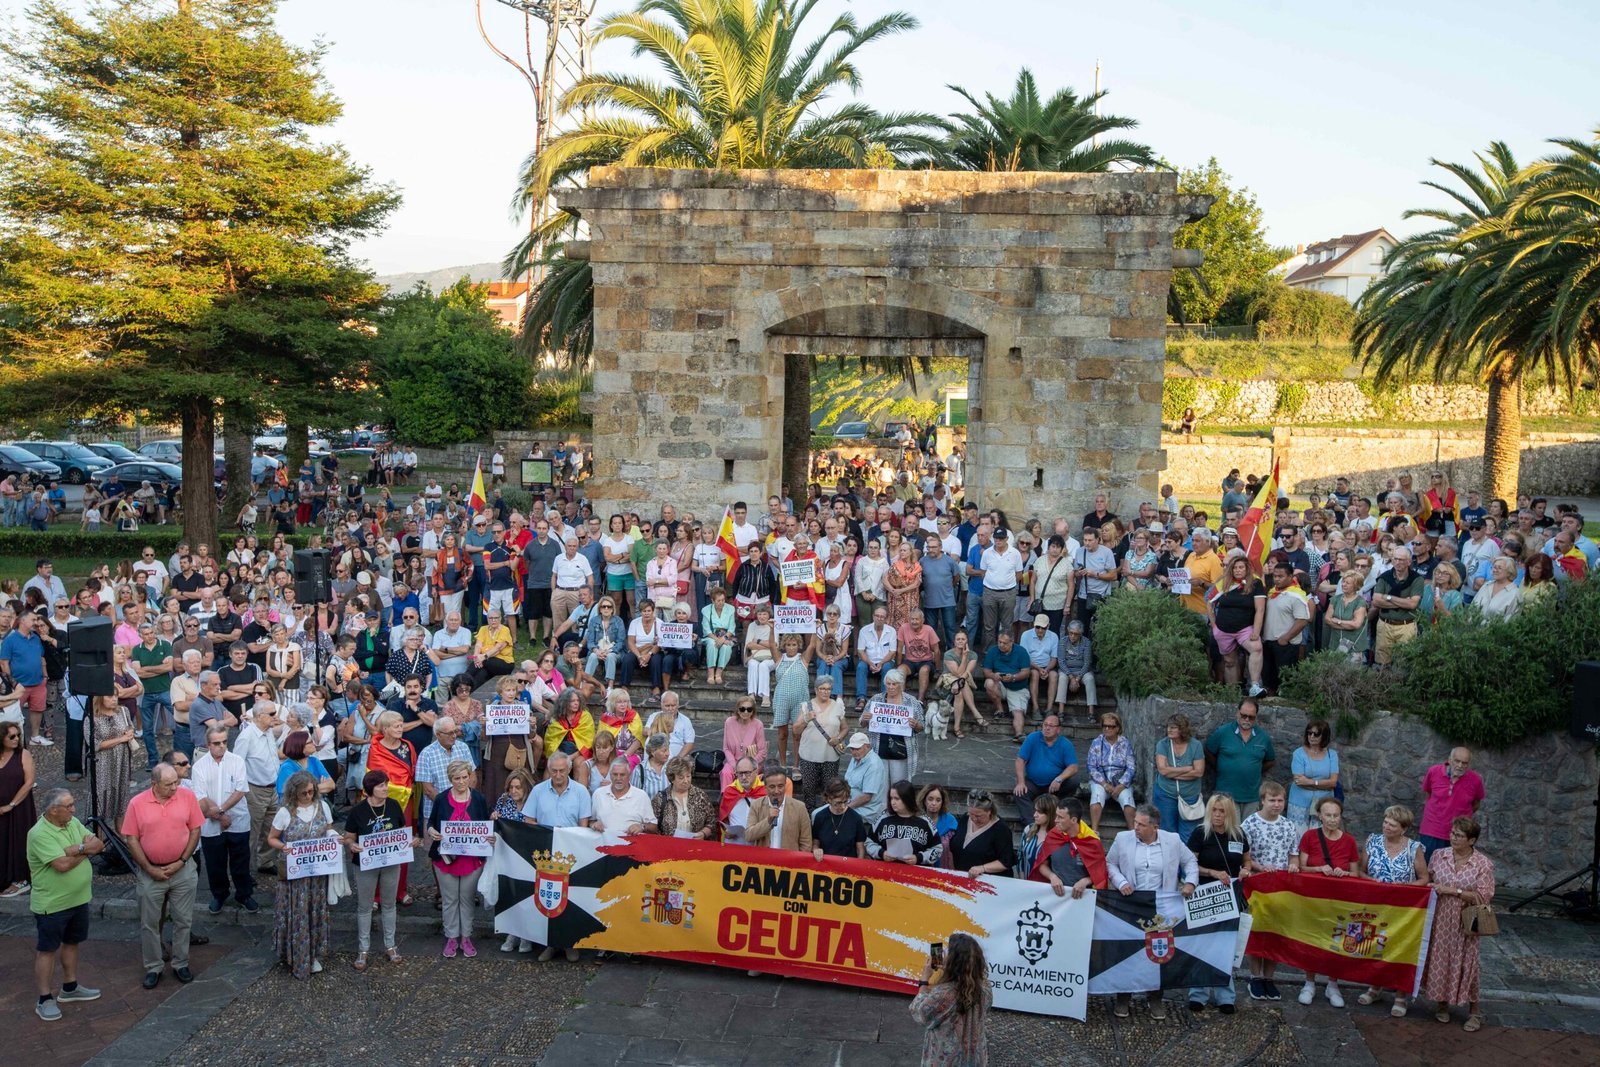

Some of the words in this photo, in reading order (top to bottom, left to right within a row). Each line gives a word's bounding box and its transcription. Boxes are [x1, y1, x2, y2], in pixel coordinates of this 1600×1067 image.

[874, 707, 909, 717] CAMARGO
[876, 716, 902, 725] CEUTA
[364, 832, 389, 840] COMERCIO
[445, 826, 489, 835] CAMARGO
[897, 825, 928, 845] VEGAS
[292, 840, 318, 848] COMERCIO
[363, 833, 408, 848] CAMARGO
[449, 836, 480, 844] CEUTA
[291, 842, 337, 856] CAMARGO
[368, 845, 399, 856] CEUTA
[296, 854, 328, 865] CEUTA
[722, 864, 874, 908] CAMARGO
[1189, 897, 1213, 910] DEFIENDE
[1214, 893, 1230, 902] CEUTA
[1194, 891, 1198, 899] A
[1199, 890, 1205, 898] LA
[783, 900, 808, 914] CON
[1191, 909, 1213, 920] DEFIENDE
[1214, 903, 1232, 914] ESPAÑA
[717, 906, 867, 969] CEUTA
[988, 962, 1085, 985] YUNTAMIENTO
[1004, 979, 1074, 998] CAMARGO
